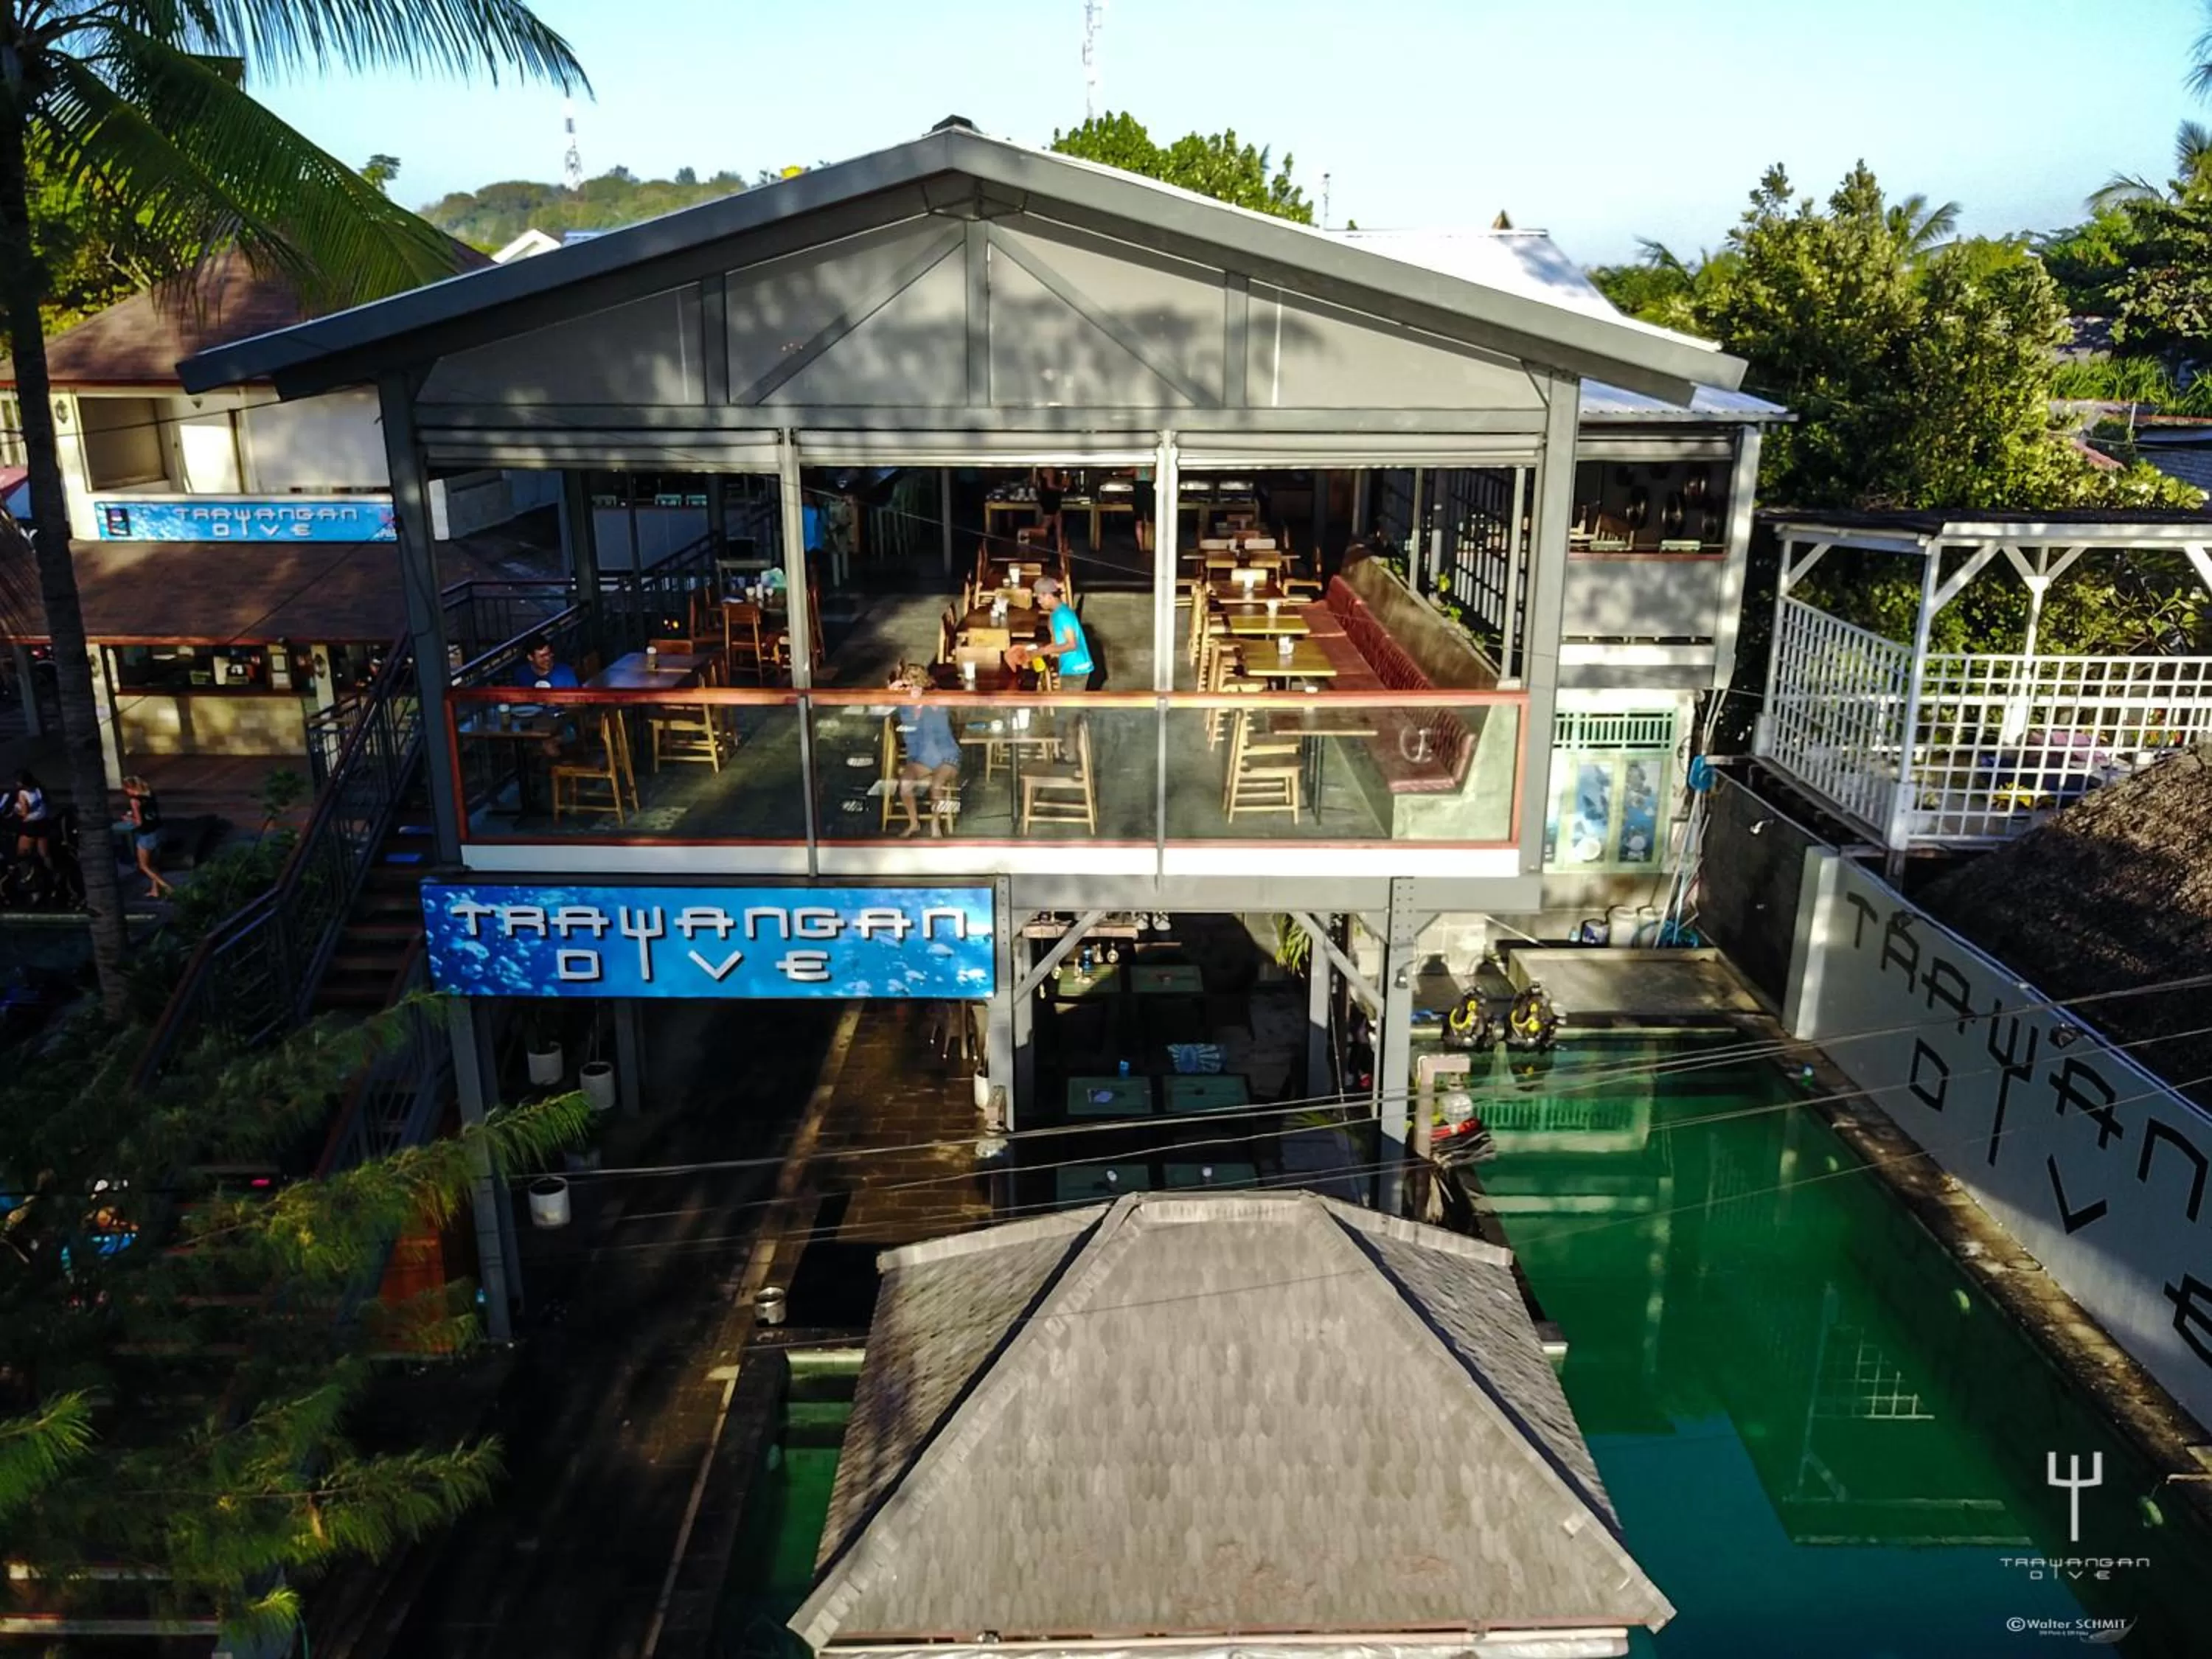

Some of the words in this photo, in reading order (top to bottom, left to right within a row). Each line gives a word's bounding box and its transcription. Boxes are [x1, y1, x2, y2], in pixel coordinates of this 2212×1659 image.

[174, 507, 358, 524] TRAWANGAN
[213, 522, 313, 538] DIVE
[451, 905, 967, 947] TRAWANGAN
[555, 942, 831, 981] DIVE
[1846, 890, 2212, 1224] TRAWAN
